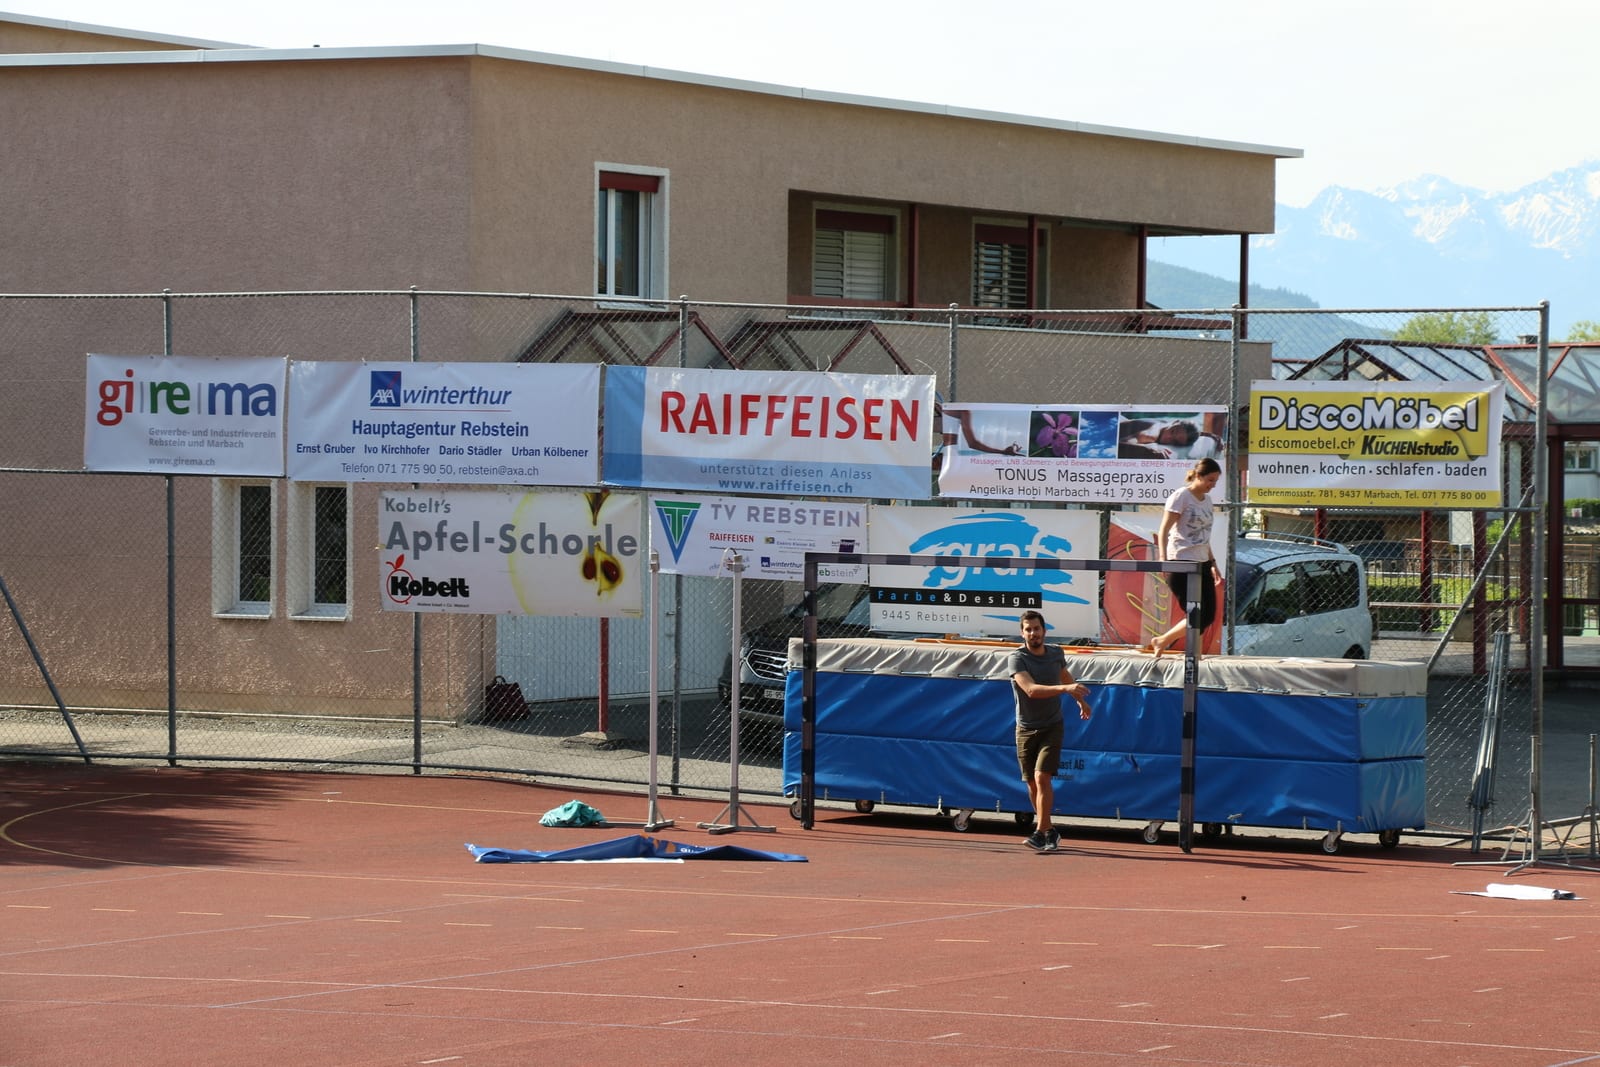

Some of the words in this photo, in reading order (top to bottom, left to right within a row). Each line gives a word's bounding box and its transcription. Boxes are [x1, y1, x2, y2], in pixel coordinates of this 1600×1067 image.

[371, 389, 396, 404] AXA
[403, 386, 512, 405] winterthur
[660, 391, 919, 442] RAIFFEISEN
[1259, 395, 1479, 432] DiscoMöbel
[149, 427, 190, 437] Gewerbe-
[192, 428, 209, 438] und
[210, 428, 276, 438] Industrieverein
[352, 419, 456, 439] Hauptagentur
[461, 421, 529, 437] Rebstein
[149, 438, 186, 447] Rebstein
[188, 439, 205, 448] und
[207, 439, 244, 448] Marbach
[296, 443, 321, 454] Ernst
[324, 443, 355, 454] Gruber
[364, 444, 378, 455] Ivo
[381, 444, 430, 455] Kirchhofer
[439, 445, 464, 456] Dario
[467, 445, 502, 456] Städler
[512, 446, 540, 457] Urban
[544, 446, 588, 458] Kölbener
[1258, 436, 1356, 450] discomoebel.ch
[149, 457, 215, 467] www.girema.ch
[341, 462, 375, 473] Telefon
[377, 463, 397, 474] 071
[401, 463, 420, 475] 775
[423, 464, 436, 475] 90
[459, 465, 539, 477] rebstein@axa.ch
[1258, 461, 1309, 475] wohnen
[1320, 462, 1366, 476] kochen
[1376, 462, 1434, 476] schlafen
[1445, 463, 1487, 477] baden
[700, 465, 774, 478] unterstützt
[781, 467, 823, 480] diesen
[830, 468, 872, 480] Anlass
[995, 468, 1047, 482] TONUS
[1057, 469, 1165, 486] Massagepraxis
[718, 478, 853, 494] www.raiffeisen.ch
[969, 484, 1014, 497] Angelika
[1018, 485, 1041, 496] Hobi
[1045, 486, 1090, 498] Marbach
[1094, 488, 1115, 498] +41
[1120, 488, 1133, 498] 79
[1138, 488, 1158, 499] 360
[1340, 490, 1361, 498] 9437
[1422, 491, 1437, 499] 071
[1441, 491, 1457, 500] 775
[1460, 492, 1472, 500] 80
[1475, 492, 1486, 500] 00
[711, 503, 736, 521] TV
[747, 506, 860, 528] REBSTEIN
[385, 519, 638, 560] Apfel-Schorle
[709, 532, 754, 543] RAIFFEISEN
[770, 561, 803, 569] winterthur
[816, 567, 854, 577] ebstein
[391, 576, 470, 598] Kobelt
[878, 590, 936, 603] Farbe
[943, 593, 952, 603] &
[959, 593, 1035, 607] Design
[881, 609, 911, 621] 9445
[917, 611, 970, 623] Rebstein
